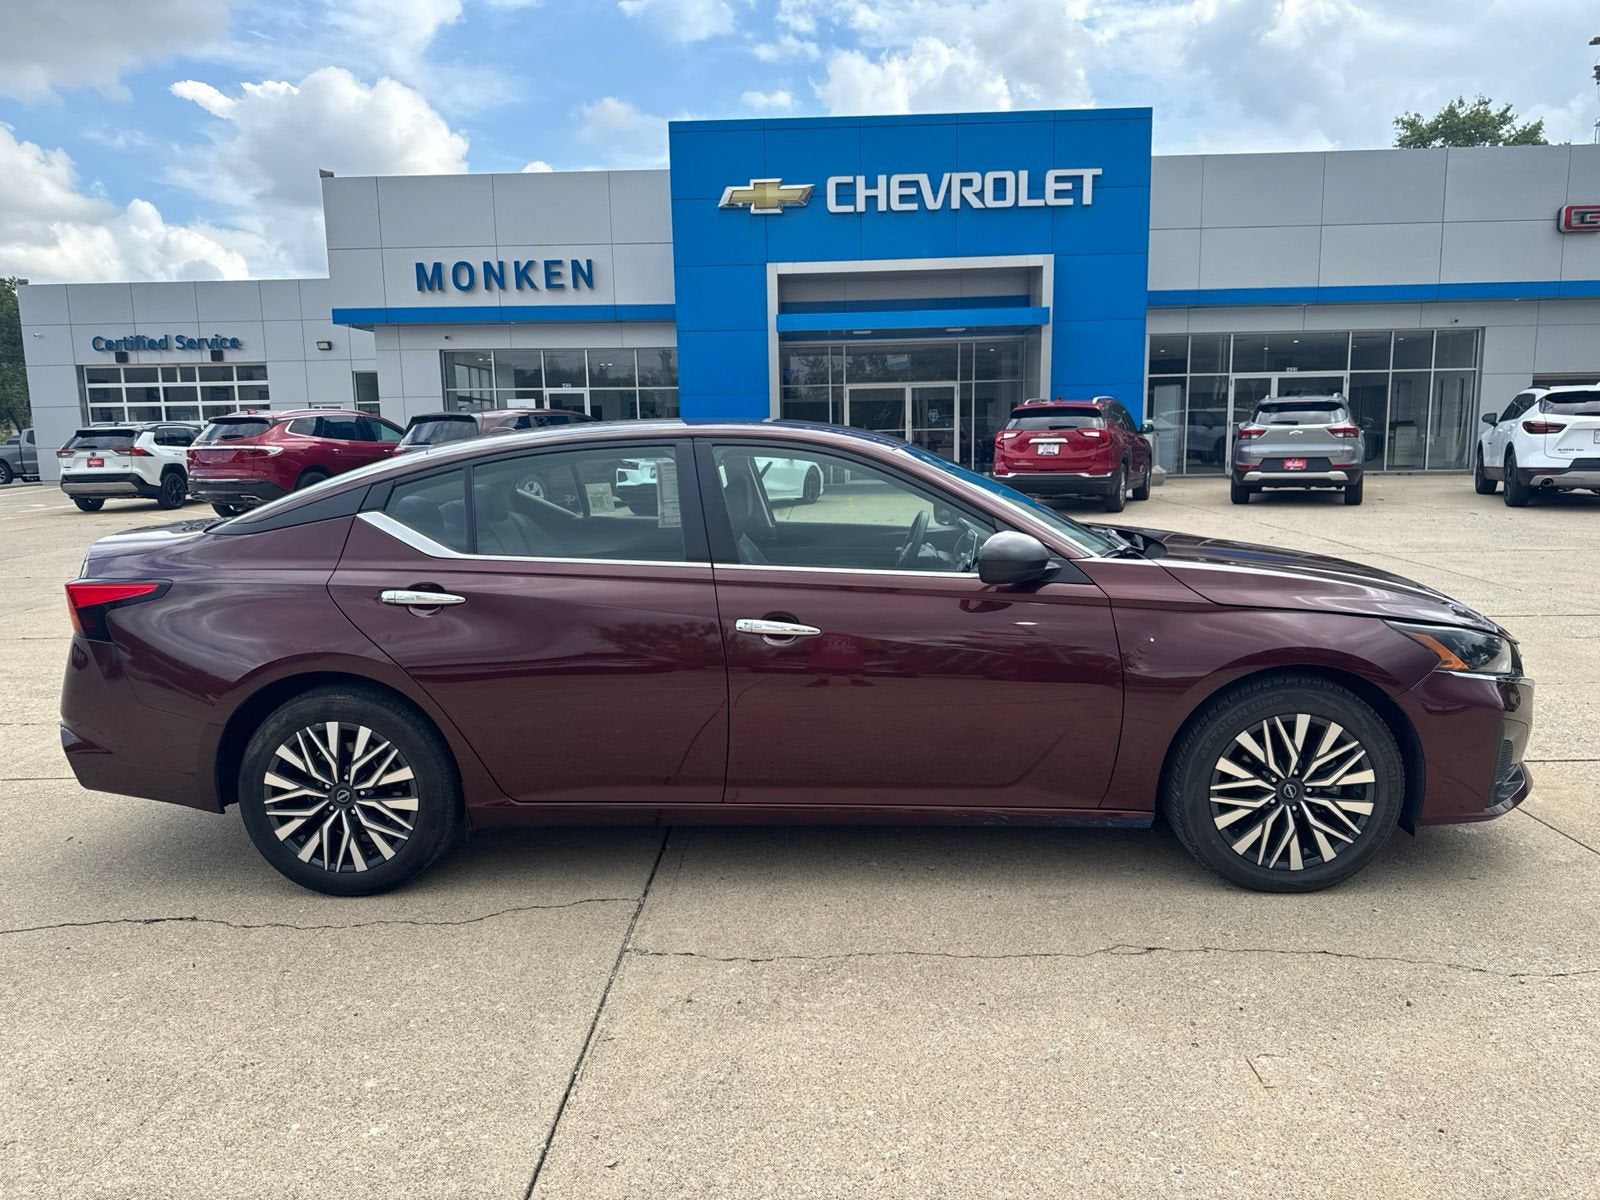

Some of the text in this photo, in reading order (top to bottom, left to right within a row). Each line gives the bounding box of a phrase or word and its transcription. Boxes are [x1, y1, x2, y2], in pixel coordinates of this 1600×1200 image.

[826, 167, 1103, 213] CHEVROLET
[415, 258, 595, 292] MONKEN
[92, 334, 241, 351] Certified Service
